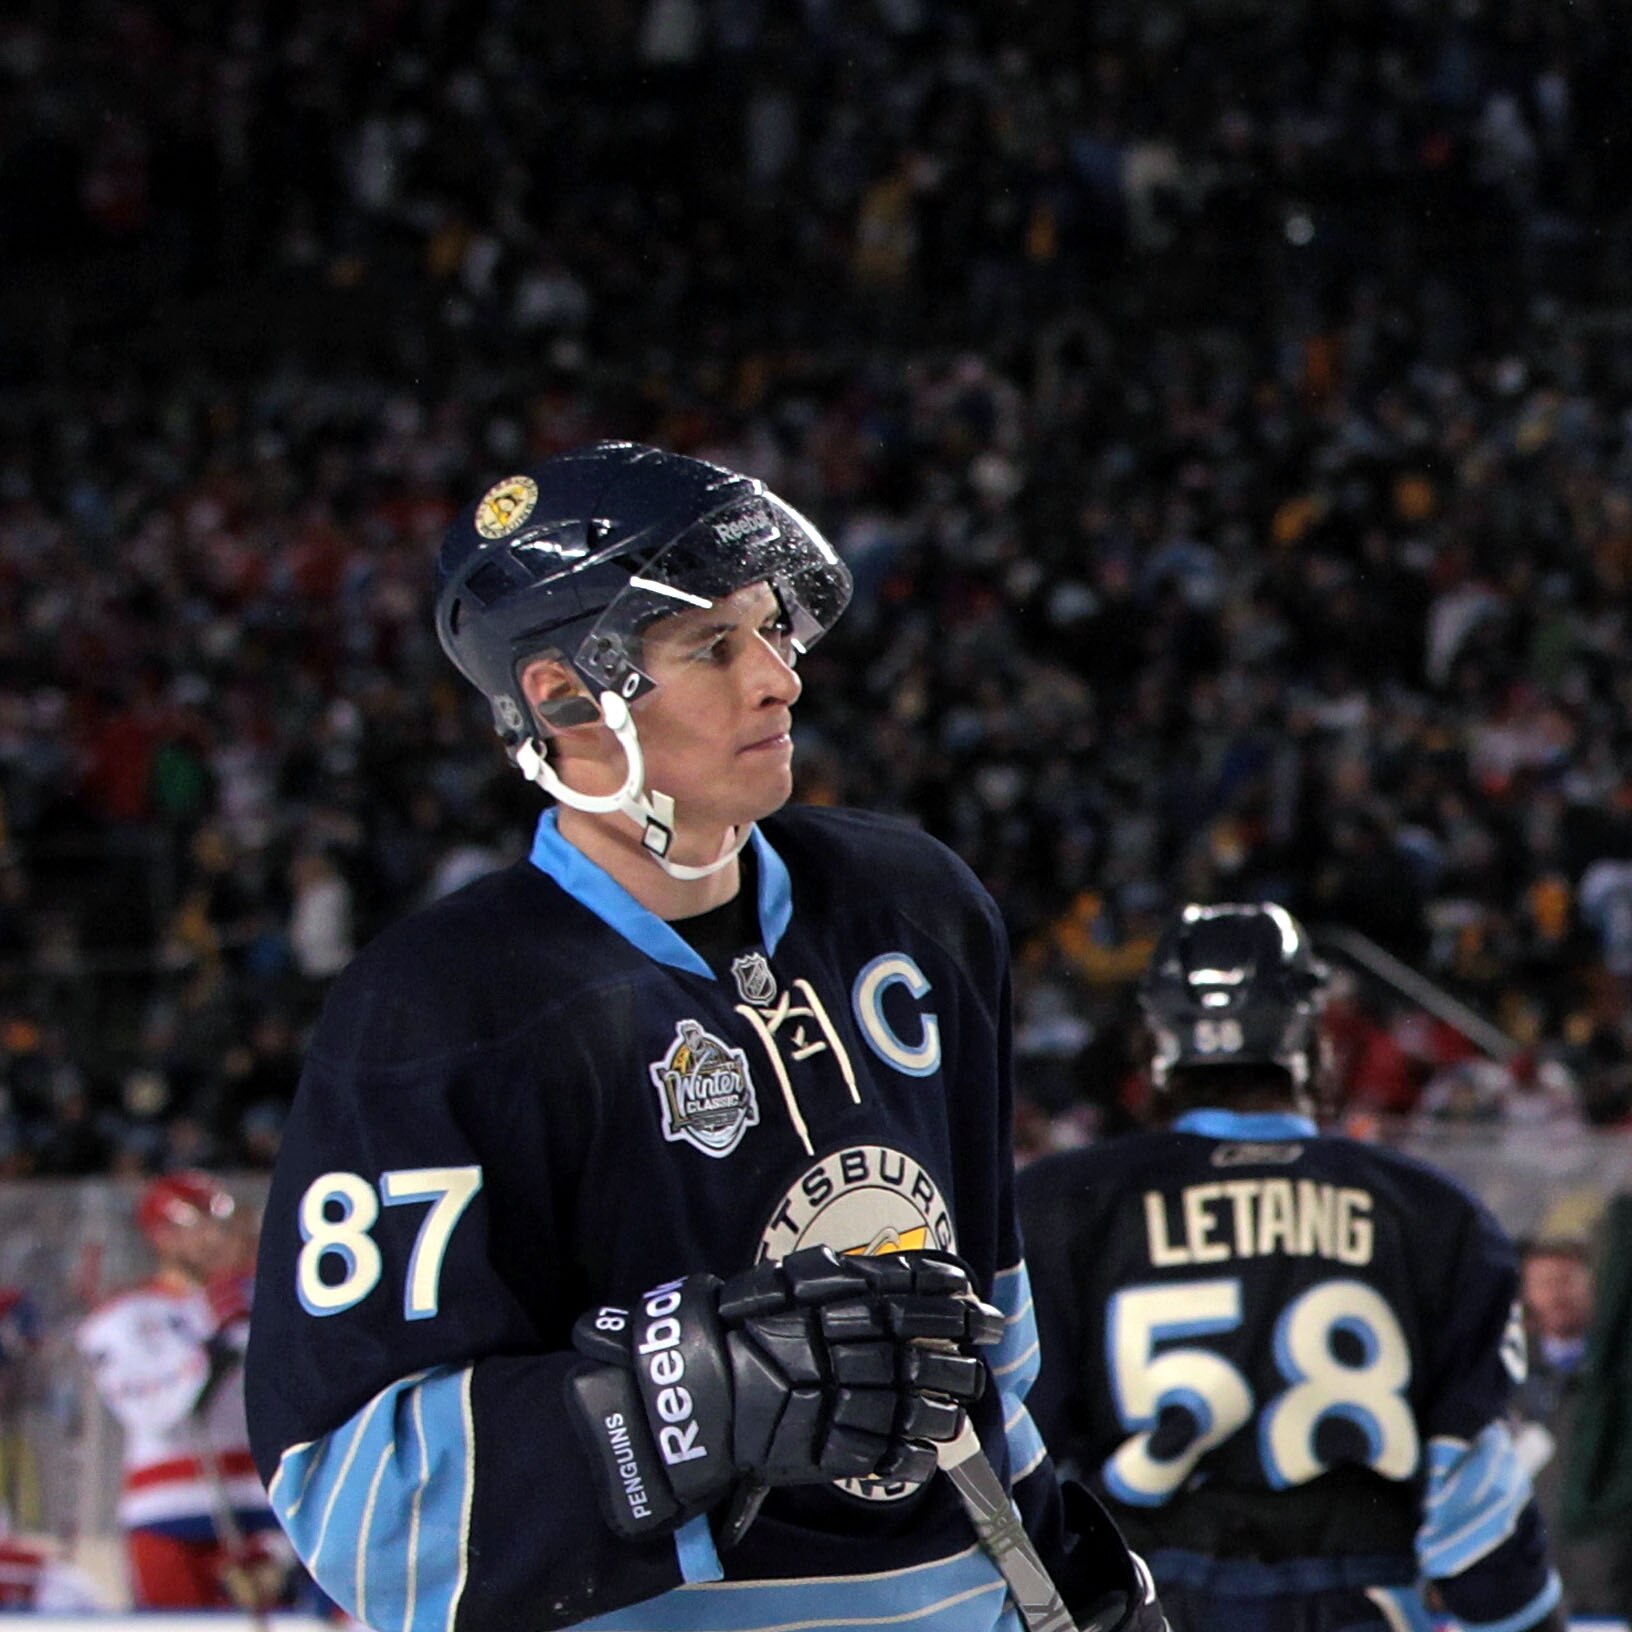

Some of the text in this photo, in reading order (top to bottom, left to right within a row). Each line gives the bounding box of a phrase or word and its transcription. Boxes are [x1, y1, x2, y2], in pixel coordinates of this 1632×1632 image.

[852, 952, 942, 1077] C
[666, 1066, 744, 1103] Winter
[686, 1095, 740, 1115] CLASSIC
[296, 1166, 483, 1321] 87
[1143, 1180, 1373, 1268] LETANG
[595, 1306, 629, 1331] 87
[1103, 1278, 1420, 1506] 58
[605, 1411, 653, 1519] PENGUINS
